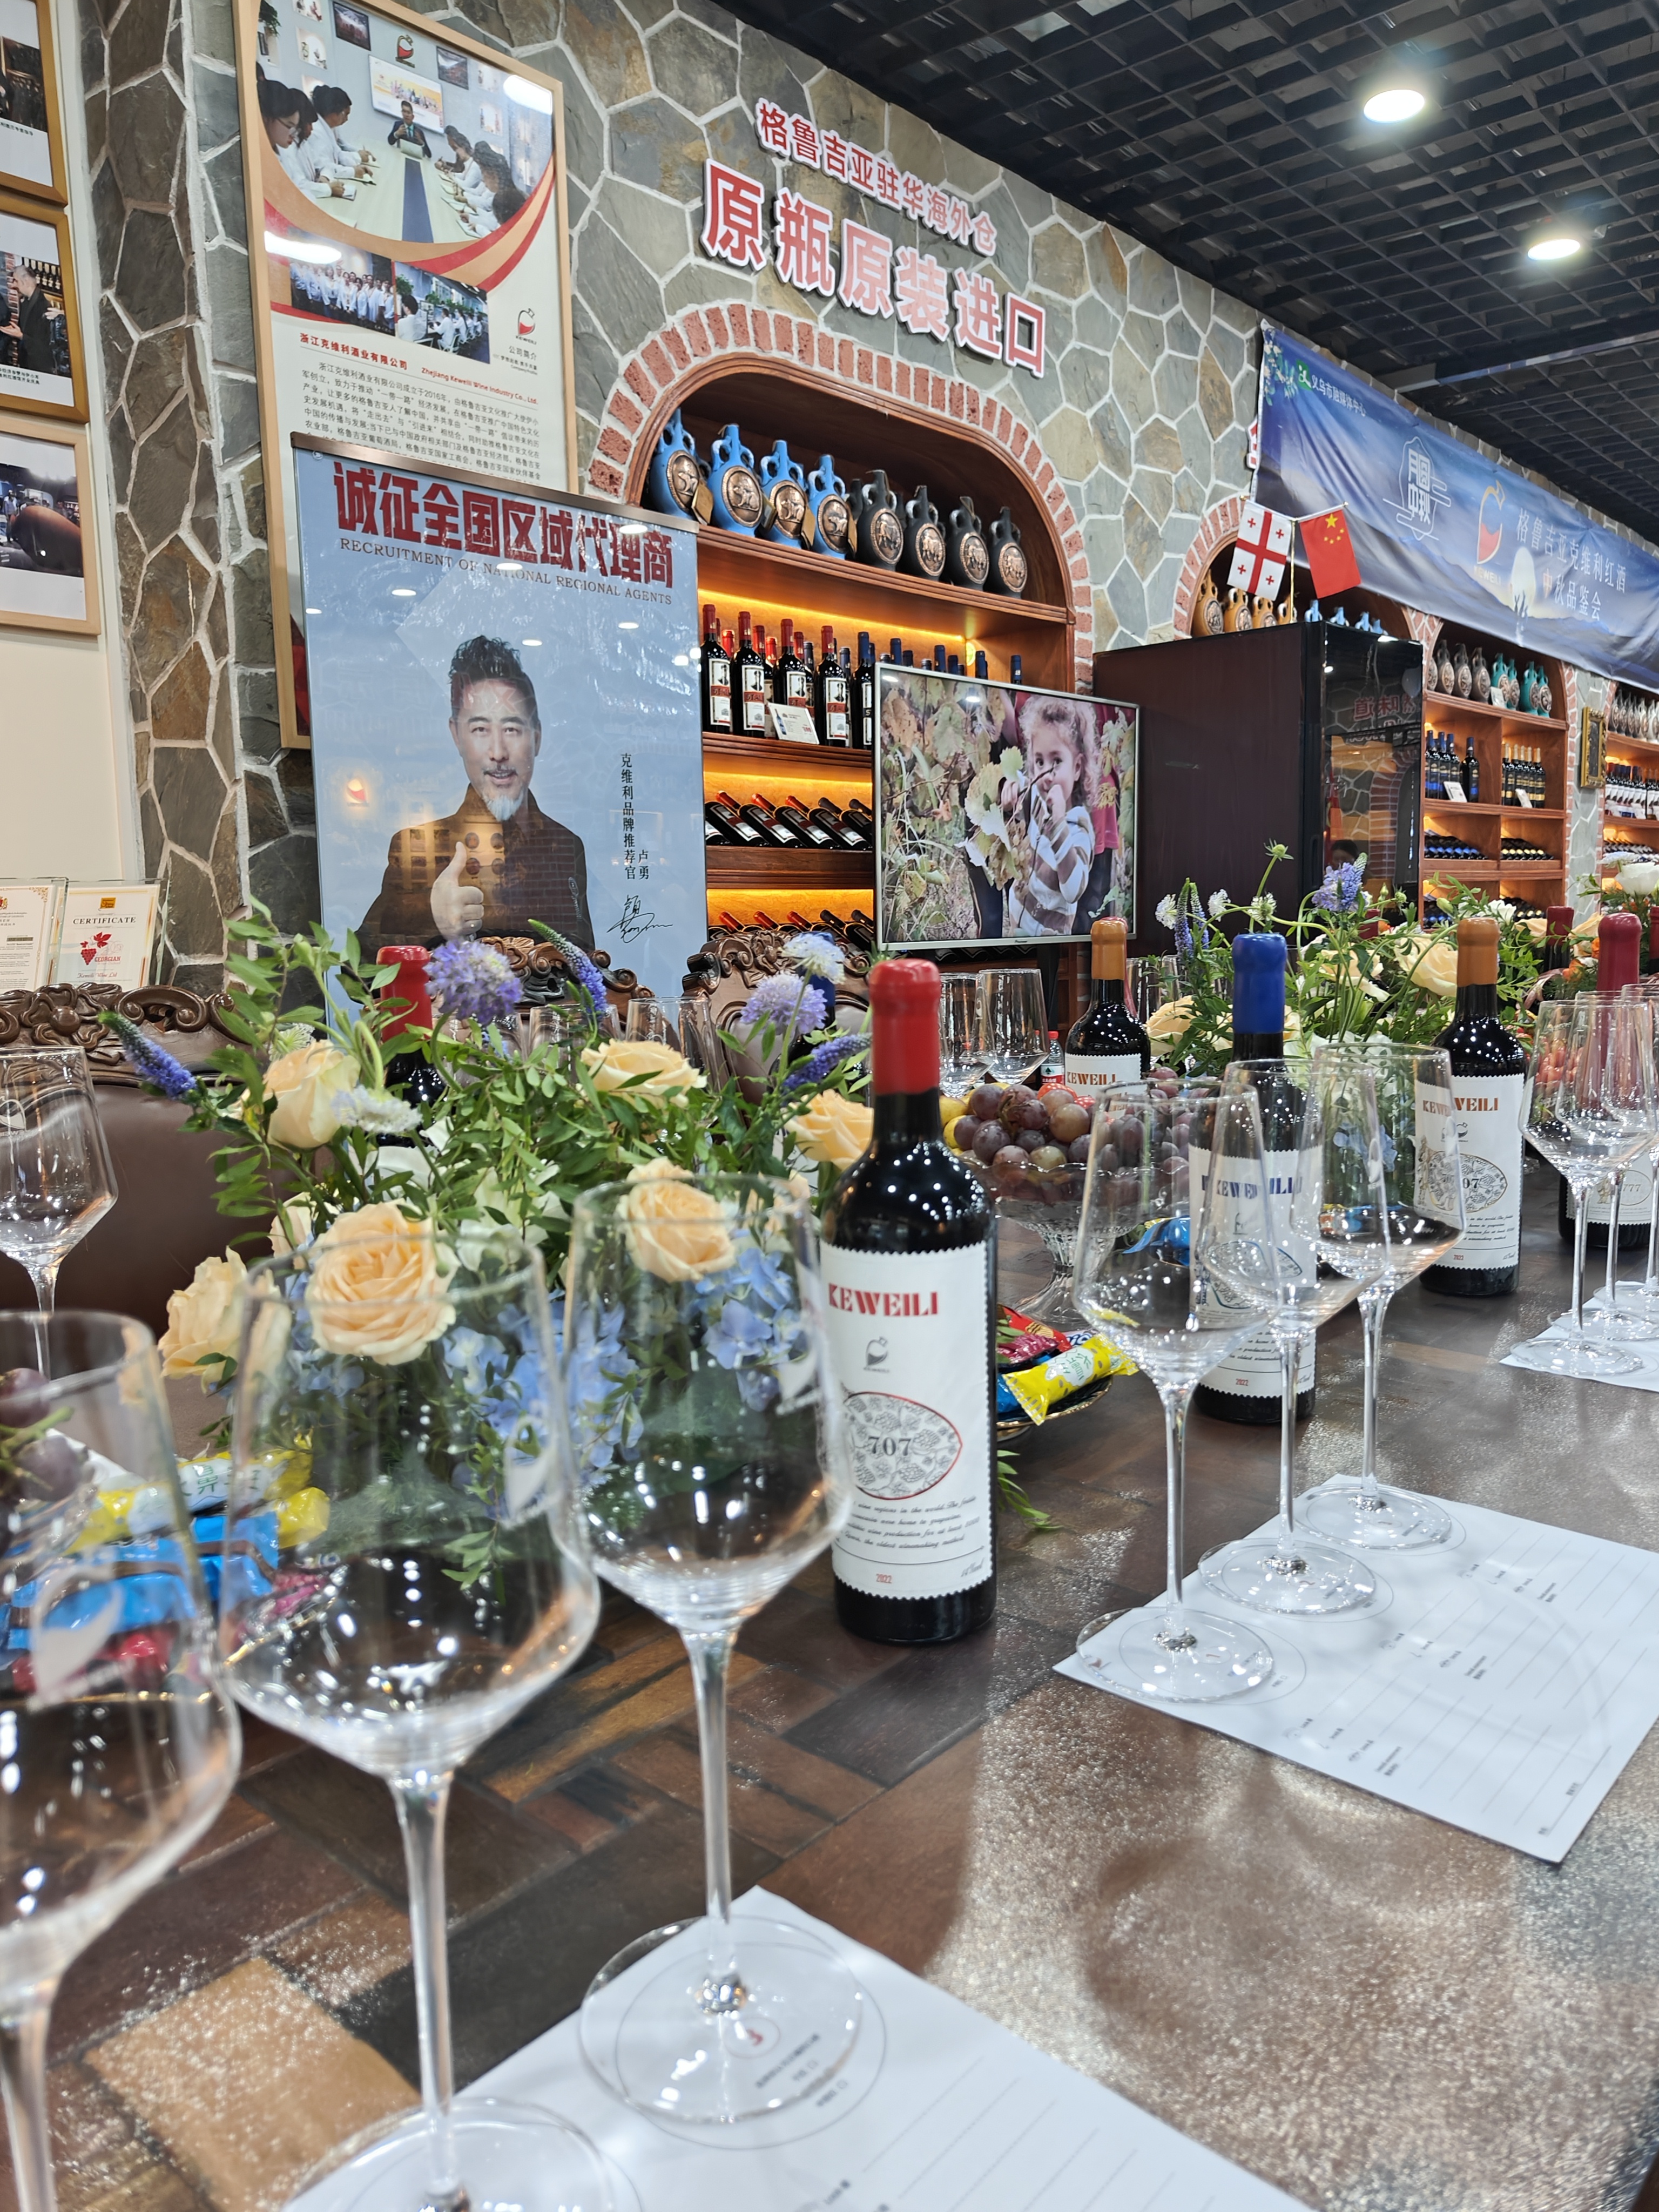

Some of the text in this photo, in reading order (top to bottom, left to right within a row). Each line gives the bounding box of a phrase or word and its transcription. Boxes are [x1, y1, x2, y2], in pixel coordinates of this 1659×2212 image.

[758, 100, 996, 255] 格鲁吉亚驻华海外仓
[704, 161, 1045, 376] 原瓶原装进口
[300, 333, 407, 370] 浙江克维利酒业有限公司
[422, 367, 449, 381] Zhejiang
[474, 382, 488, 391] Wine
[490, 387, 514, 399] Industry
[1312, 375, 1366, 417] 义乌市融媒体中心
[333, 461, 673, 589] 诚征全国区域代理商
[340, 538, 673, 605] RECRUITMENT OF NATIONAL REGIONAL AGENTS
[1517, 508, 1626, 593] 格鲁吉亚克维利红酒
[1543, 568, 1601, 621] 中秋品鉴会
[621, 753, 636, 880] 克维利品牌推荐官
[638, 849, 650, 880] 卢勇
[73, 917, 136, 925] CERTIFICATE
[829, 1283, 938, 1317] KEWEILI
[869, 1435, 913, 1456] 707
[876, 1573, 892, 1583] 2022
